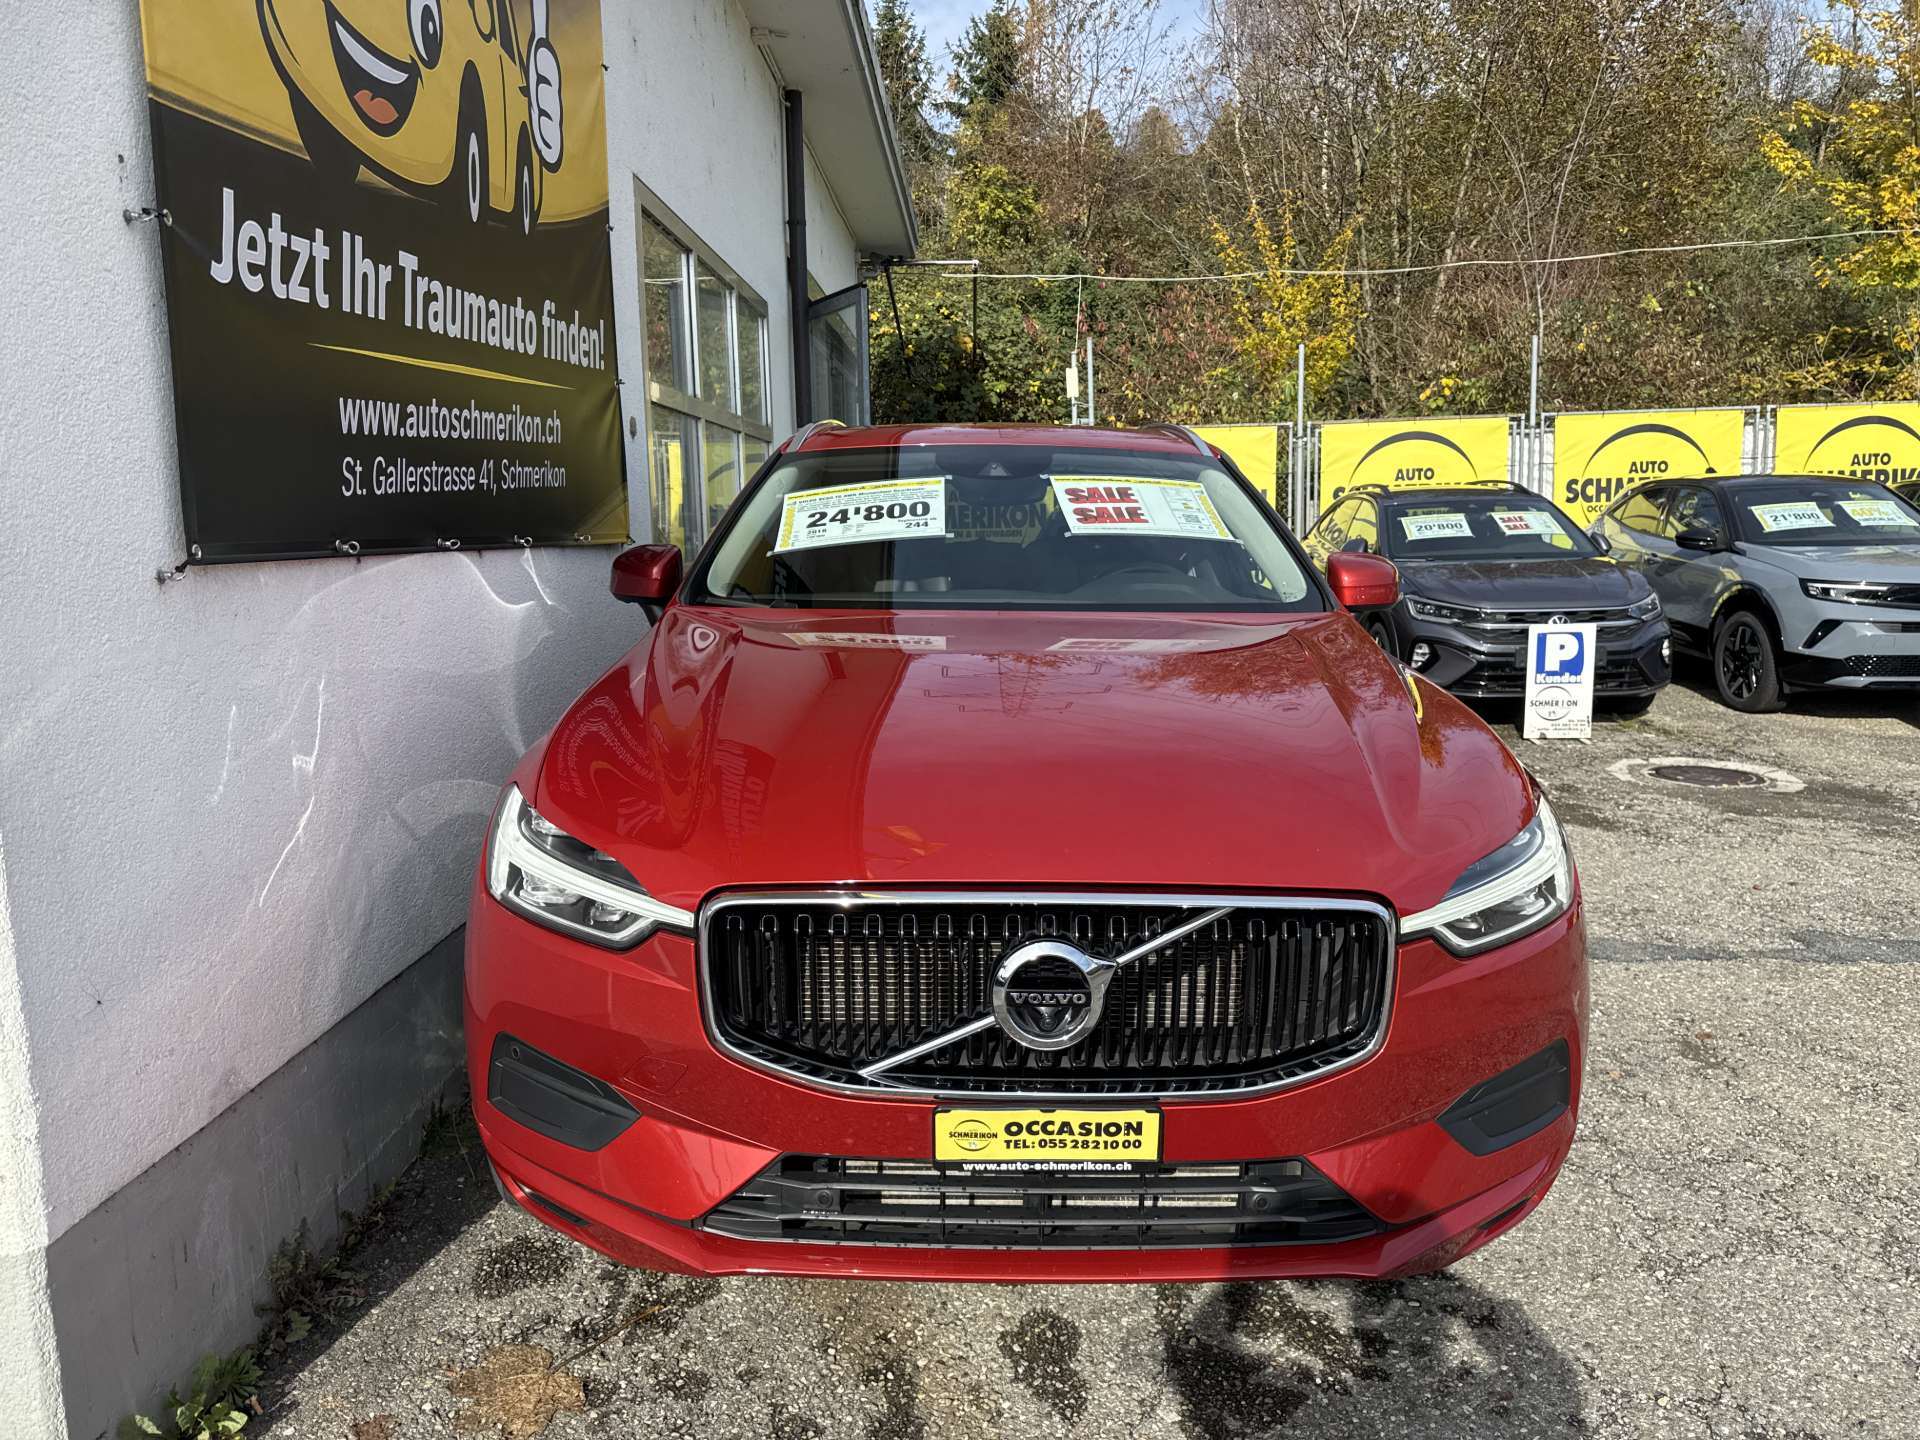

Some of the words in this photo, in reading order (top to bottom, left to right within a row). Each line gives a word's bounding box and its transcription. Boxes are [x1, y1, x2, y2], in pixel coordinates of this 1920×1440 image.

[210, 187, 330, 309] Jetzt
[342, 230, 392, 321] Ihr
[398, 250, 537, 356] Traumauto
[541, 299, 605, 371] finden!
[339, 397, 562, 444] www.autoschmerikon.ch
[1628, 460, 1669, 474] AUTO
[1850, 453, 1892, 467] AUTO
[341, 456, 367, 497] St.
[372, 455, 476, 496] Gallerstrasse
[478, 458, 497, 497] 41,
[501, 458, 566, 490] Schmerikon
[1394, 467, 1435, 482] AUTO
[1064, 486, 1140, 504] SALE
[806, 501, 931, 529] 24'800
[1072, 506, 1150, 525] SALE
[1544, 633, 1580, 673] P
[1009, 992, 1086, 1005] VOLVO
[948, 1130, 998, 1139] SCHMERIKON
[1003, 1120, 1143, 1138] OCCASION
[1003, 1139, 1035, 1150] TEL:
[962, 1161, 1133, 1171] www.auto-schmerikon.ch
